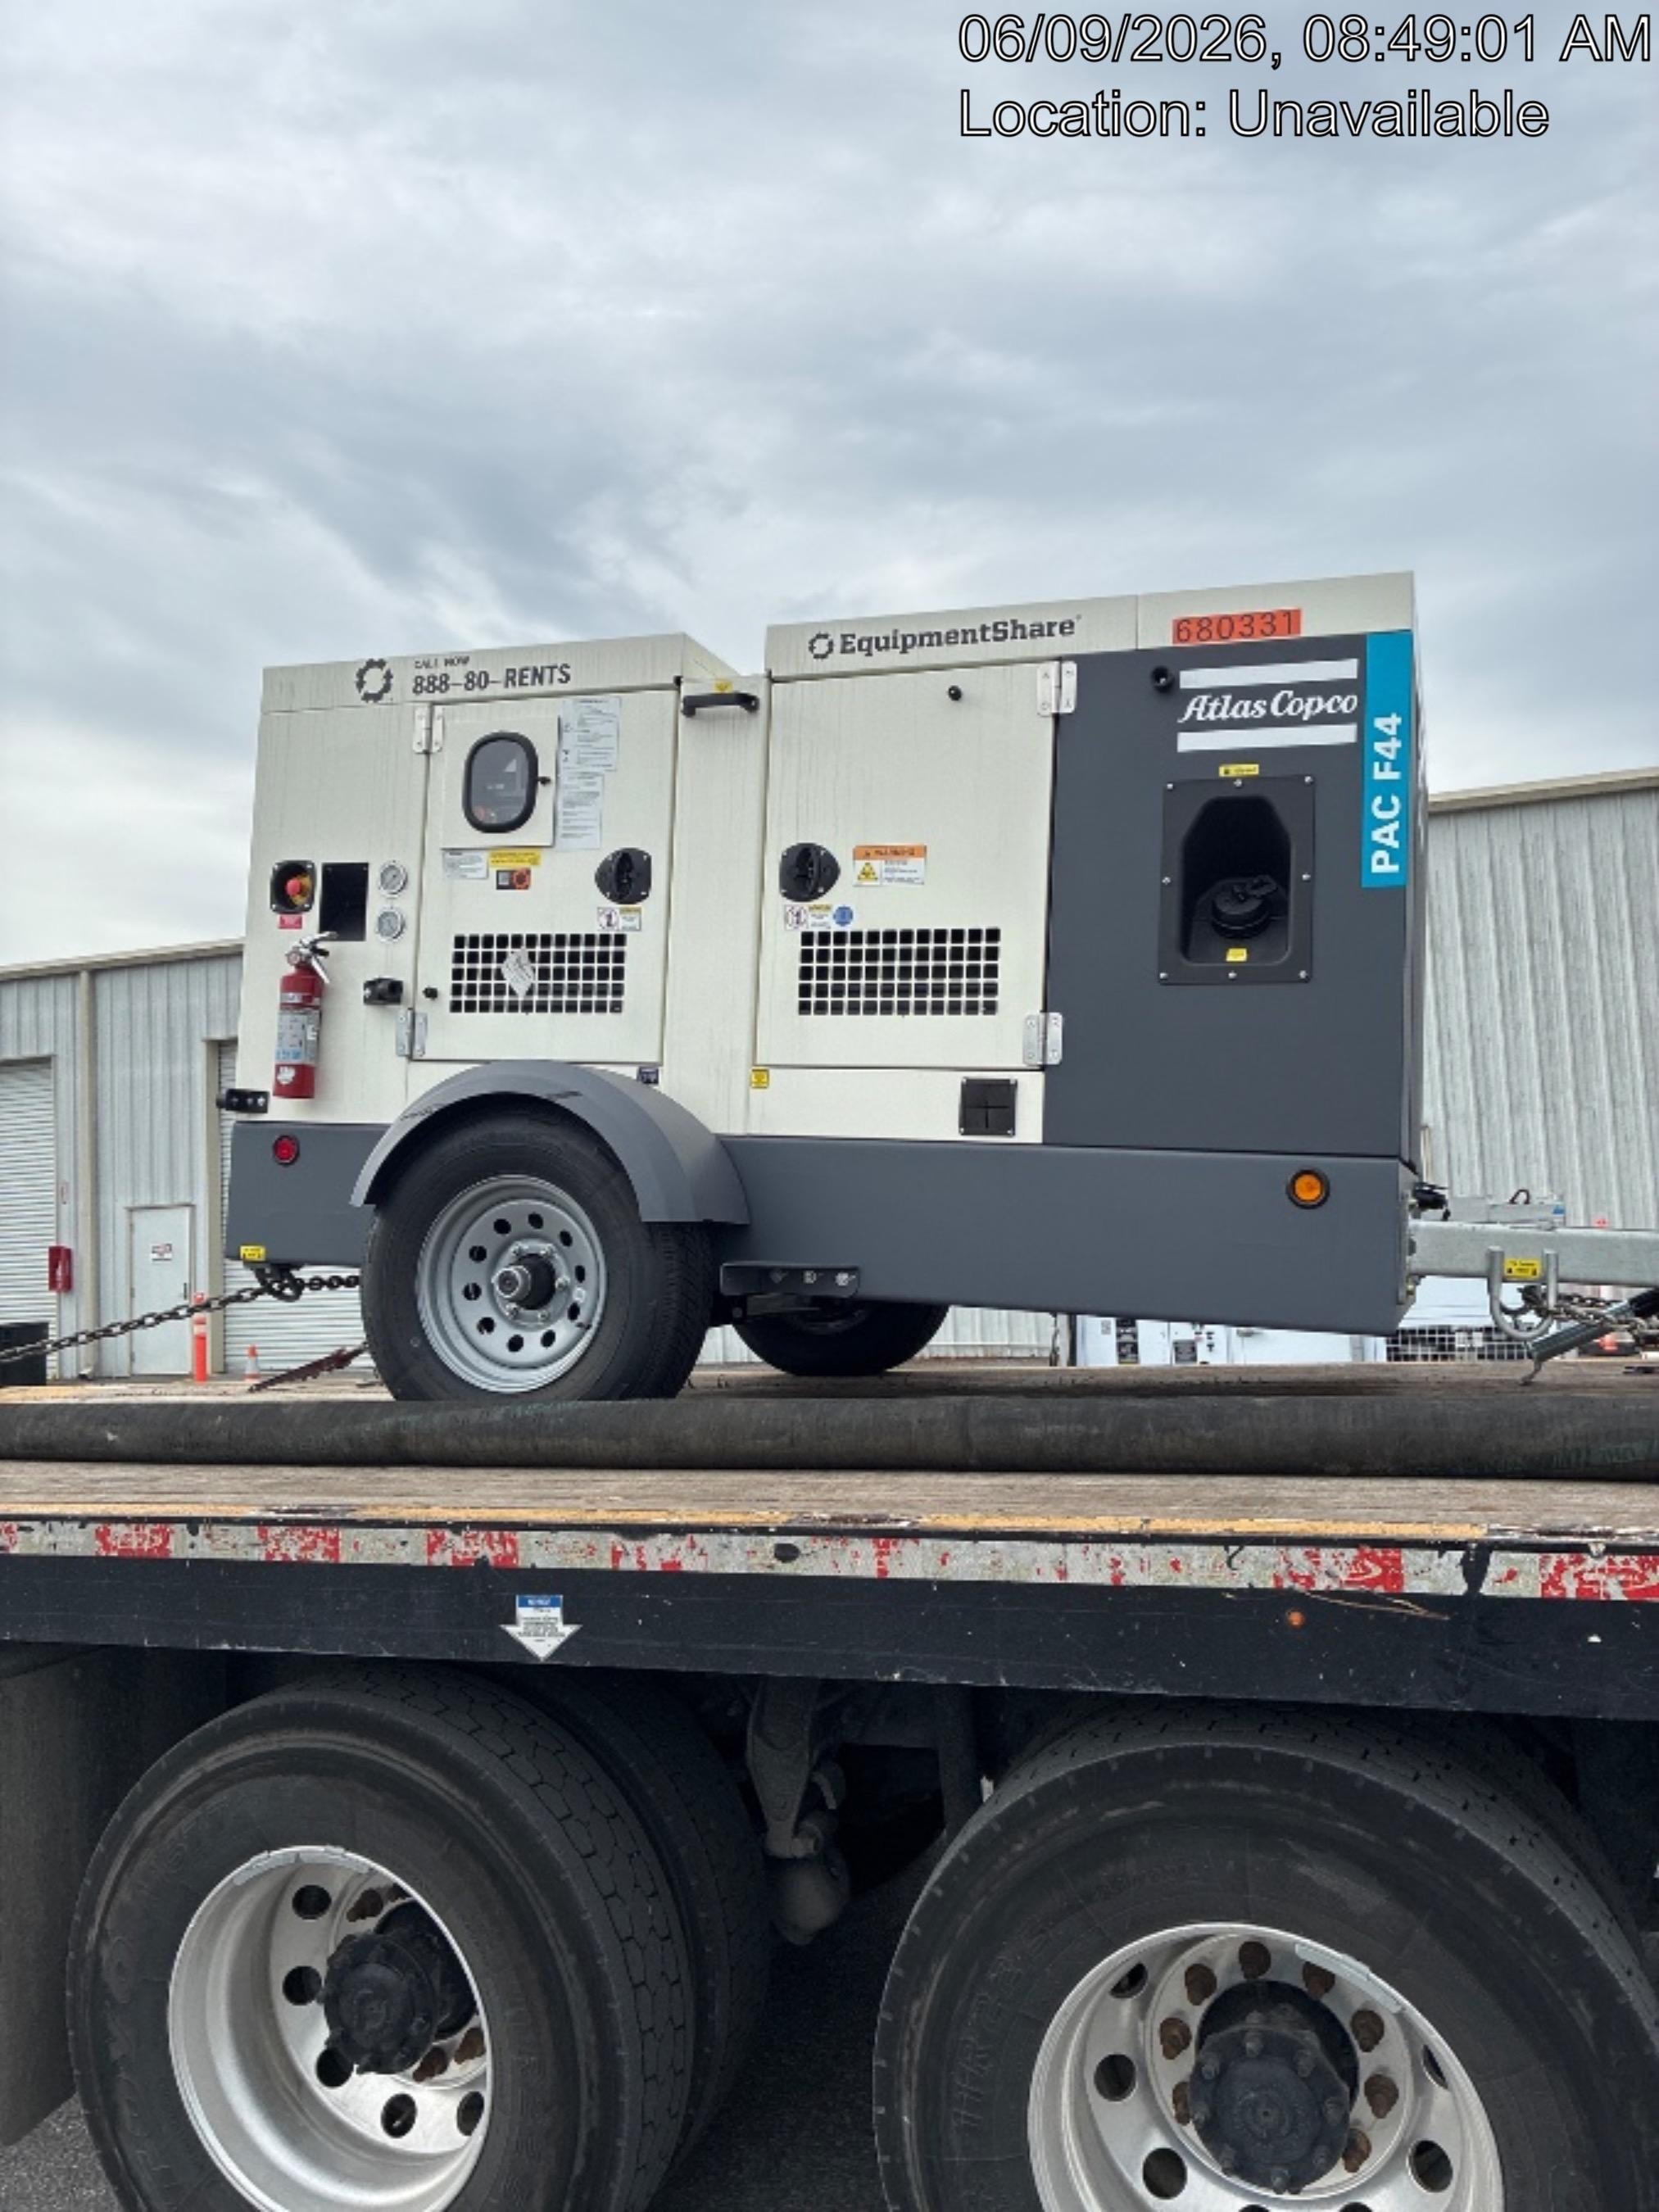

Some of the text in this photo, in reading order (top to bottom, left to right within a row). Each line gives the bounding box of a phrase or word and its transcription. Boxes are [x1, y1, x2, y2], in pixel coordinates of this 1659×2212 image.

[839, 619, 1077, 657] EquipmentShare
[1176, 611, 1293, 641] 680331
[411, 662, 572, 696] 888-80-RENTS
[1177, 690, 1358, 723] Atlas Copco
[1371, 712, 1403, 874] PAC F44
